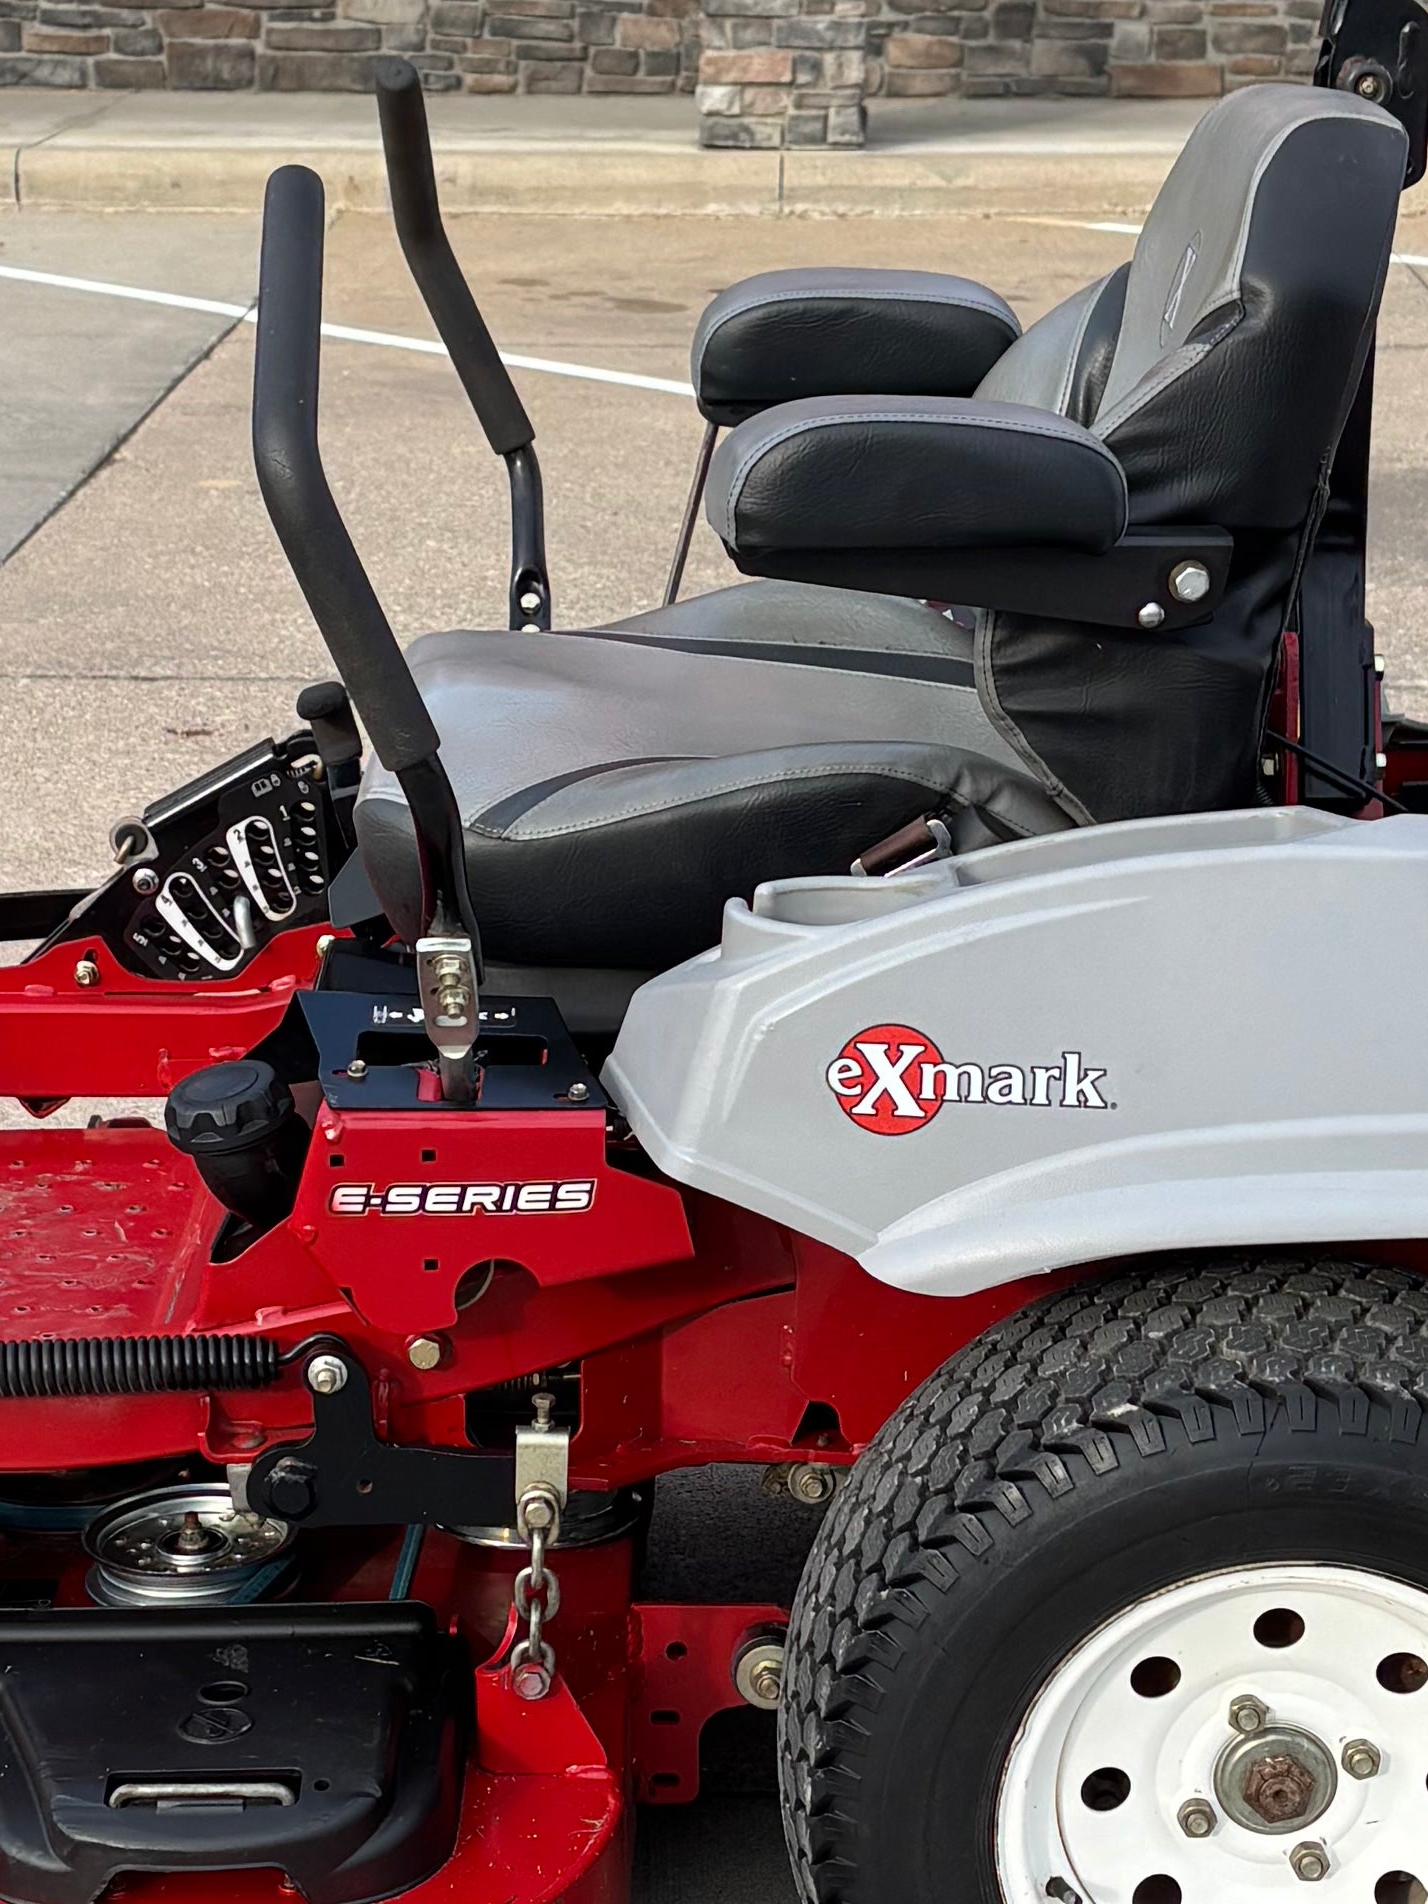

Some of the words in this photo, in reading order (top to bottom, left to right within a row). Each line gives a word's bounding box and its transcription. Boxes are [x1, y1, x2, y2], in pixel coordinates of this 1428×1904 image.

[279, 805, 290, 821] 1
[232, 829, 246, 843] 2
[192, 857, 207, 872] 3
[132, 933, 148, 946] 5
[330, 1180, 596, 1214] E-SERIES
